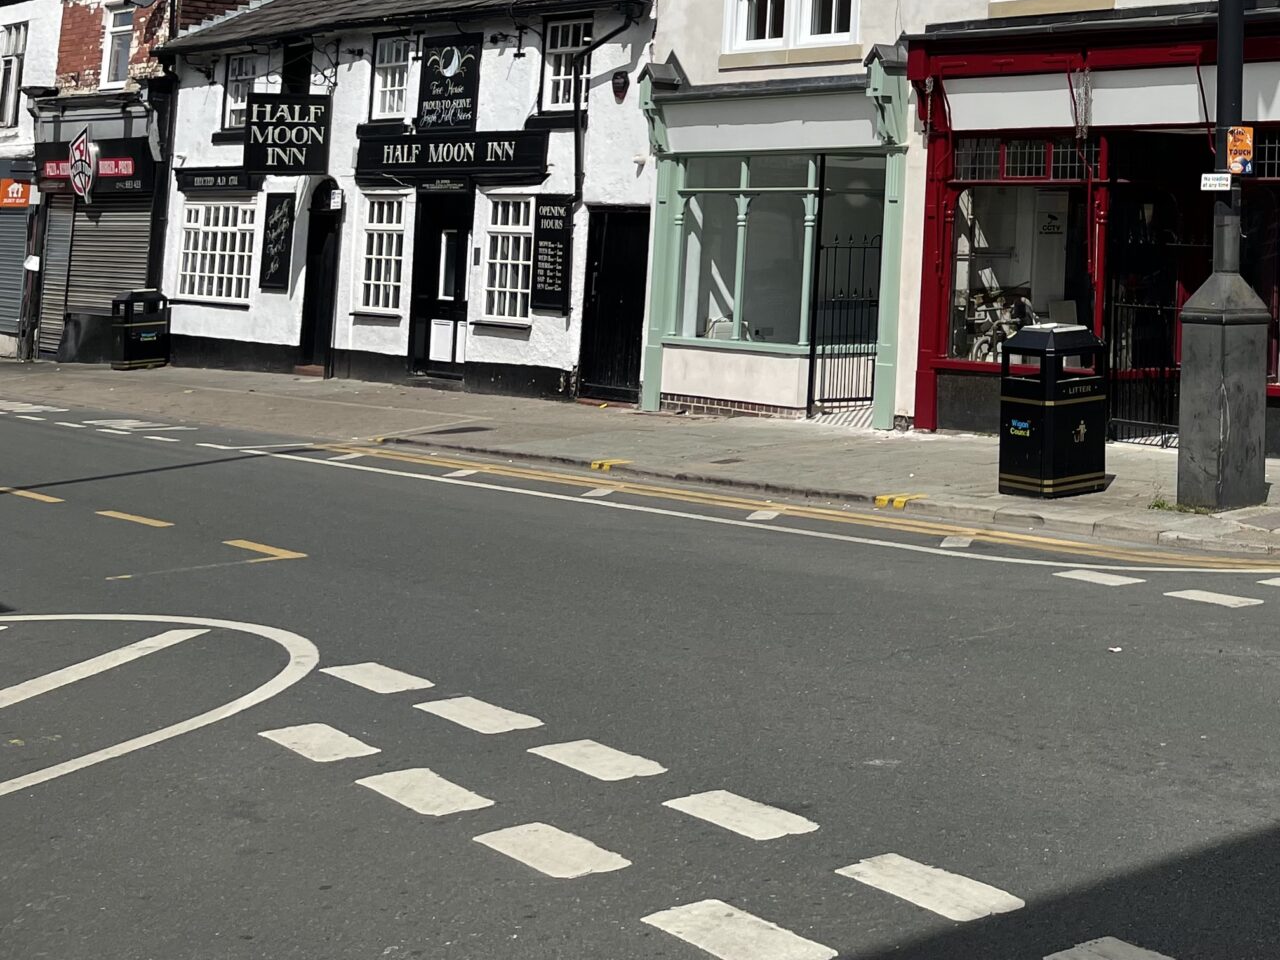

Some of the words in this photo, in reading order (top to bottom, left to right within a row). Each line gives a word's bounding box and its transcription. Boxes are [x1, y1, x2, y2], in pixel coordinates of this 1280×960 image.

[250, 103, 325, 124] HALF
[249, 125, 325, 145] MOON
[265, 147, 307, 166] INN
[382, 144, 422, 164] HALF
[428, 142, 476, 163] MOON
[486, 141, 516, 161] INN
[1229, 148, 1252, 157] TOUCH
[1211, 175, 1229, 183] loading
[538, 205, 567, 217] OPENING
[540, 218, 564, 230] HOURS
[1042, 224, 1061, 232] CCTV
[1068, 384, 1092, 395] LITTER
[1011, 419, 1030, 430] Wigan
[1009, 427, 1030, 438] Council
